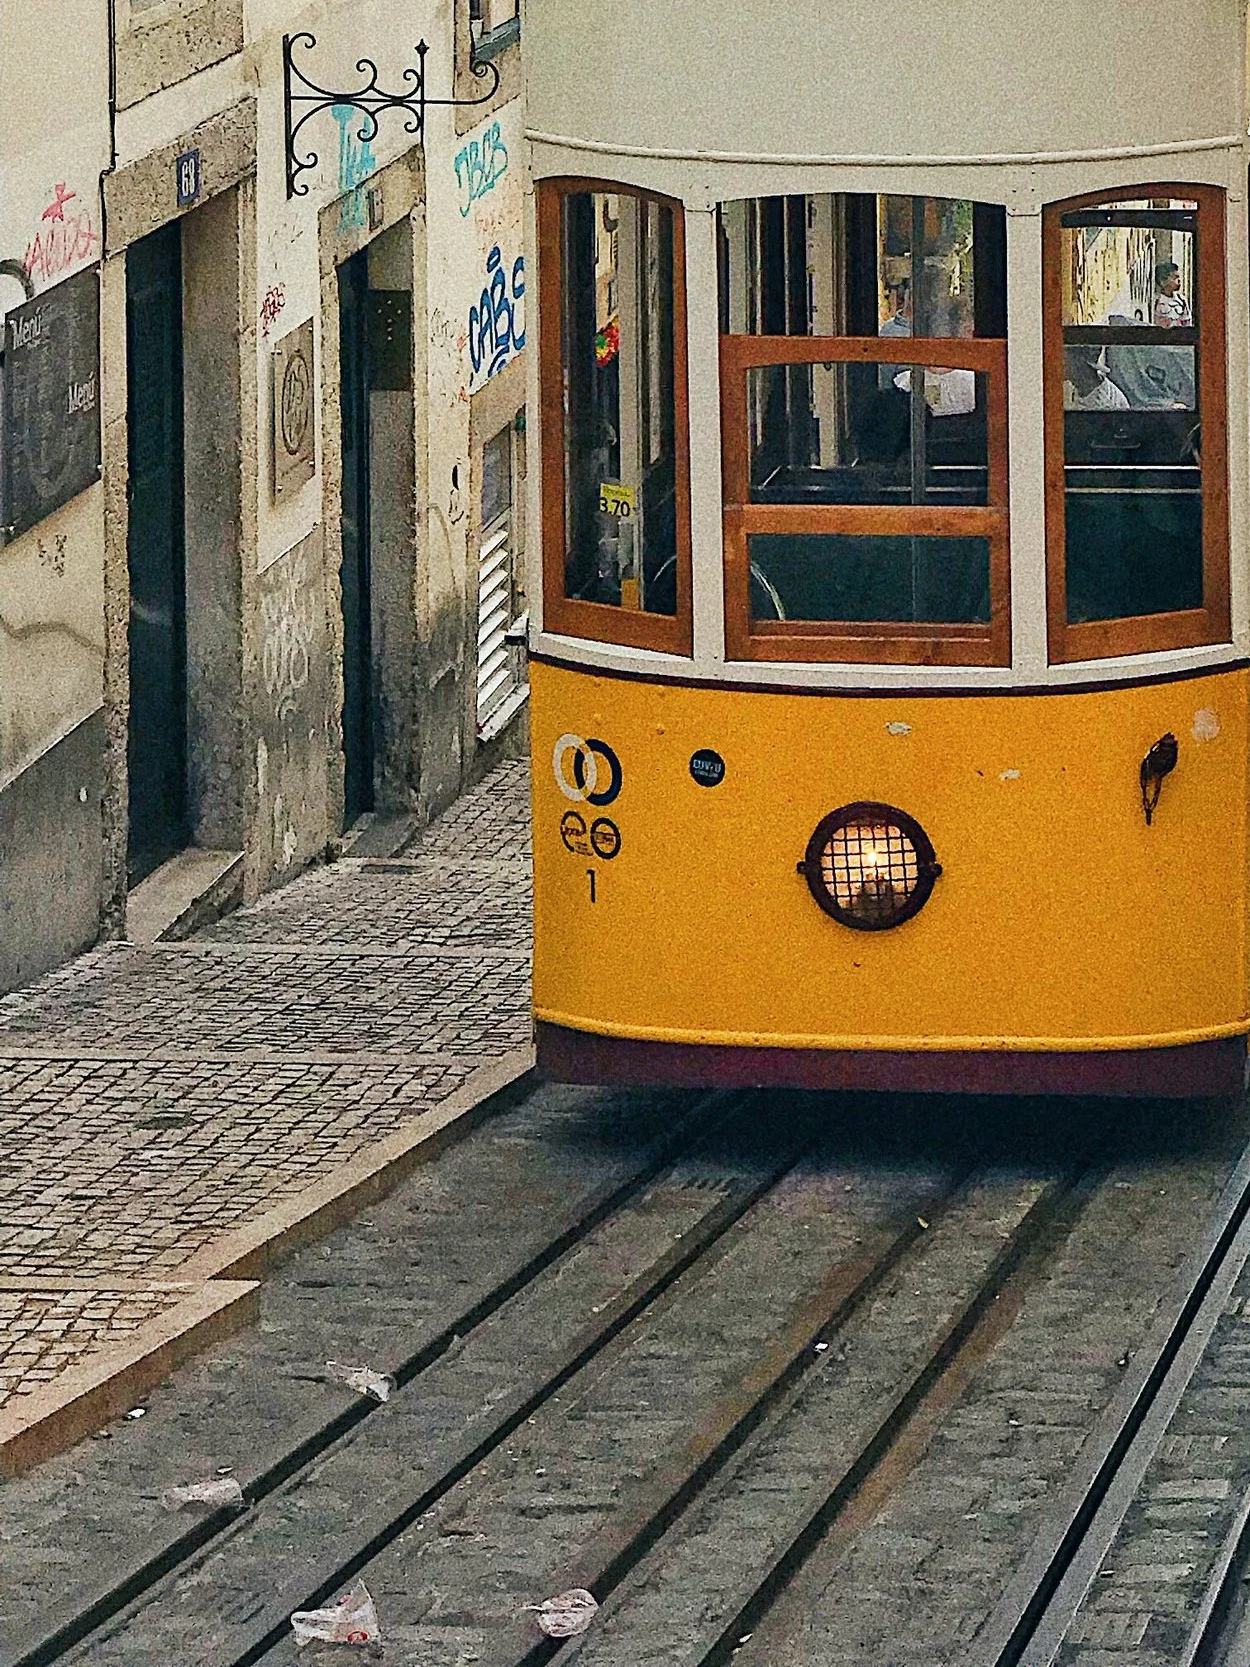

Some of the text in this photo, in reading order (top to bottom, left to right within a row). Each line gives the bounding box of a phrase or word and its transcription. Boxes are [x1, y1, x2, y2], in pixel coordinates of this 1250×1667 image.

[181, 158, 195, 197] 68
[9, 307, 42, 350] Menú
[67, 371, 96, 414] Menú
[586, 869, 596, 903] 1
